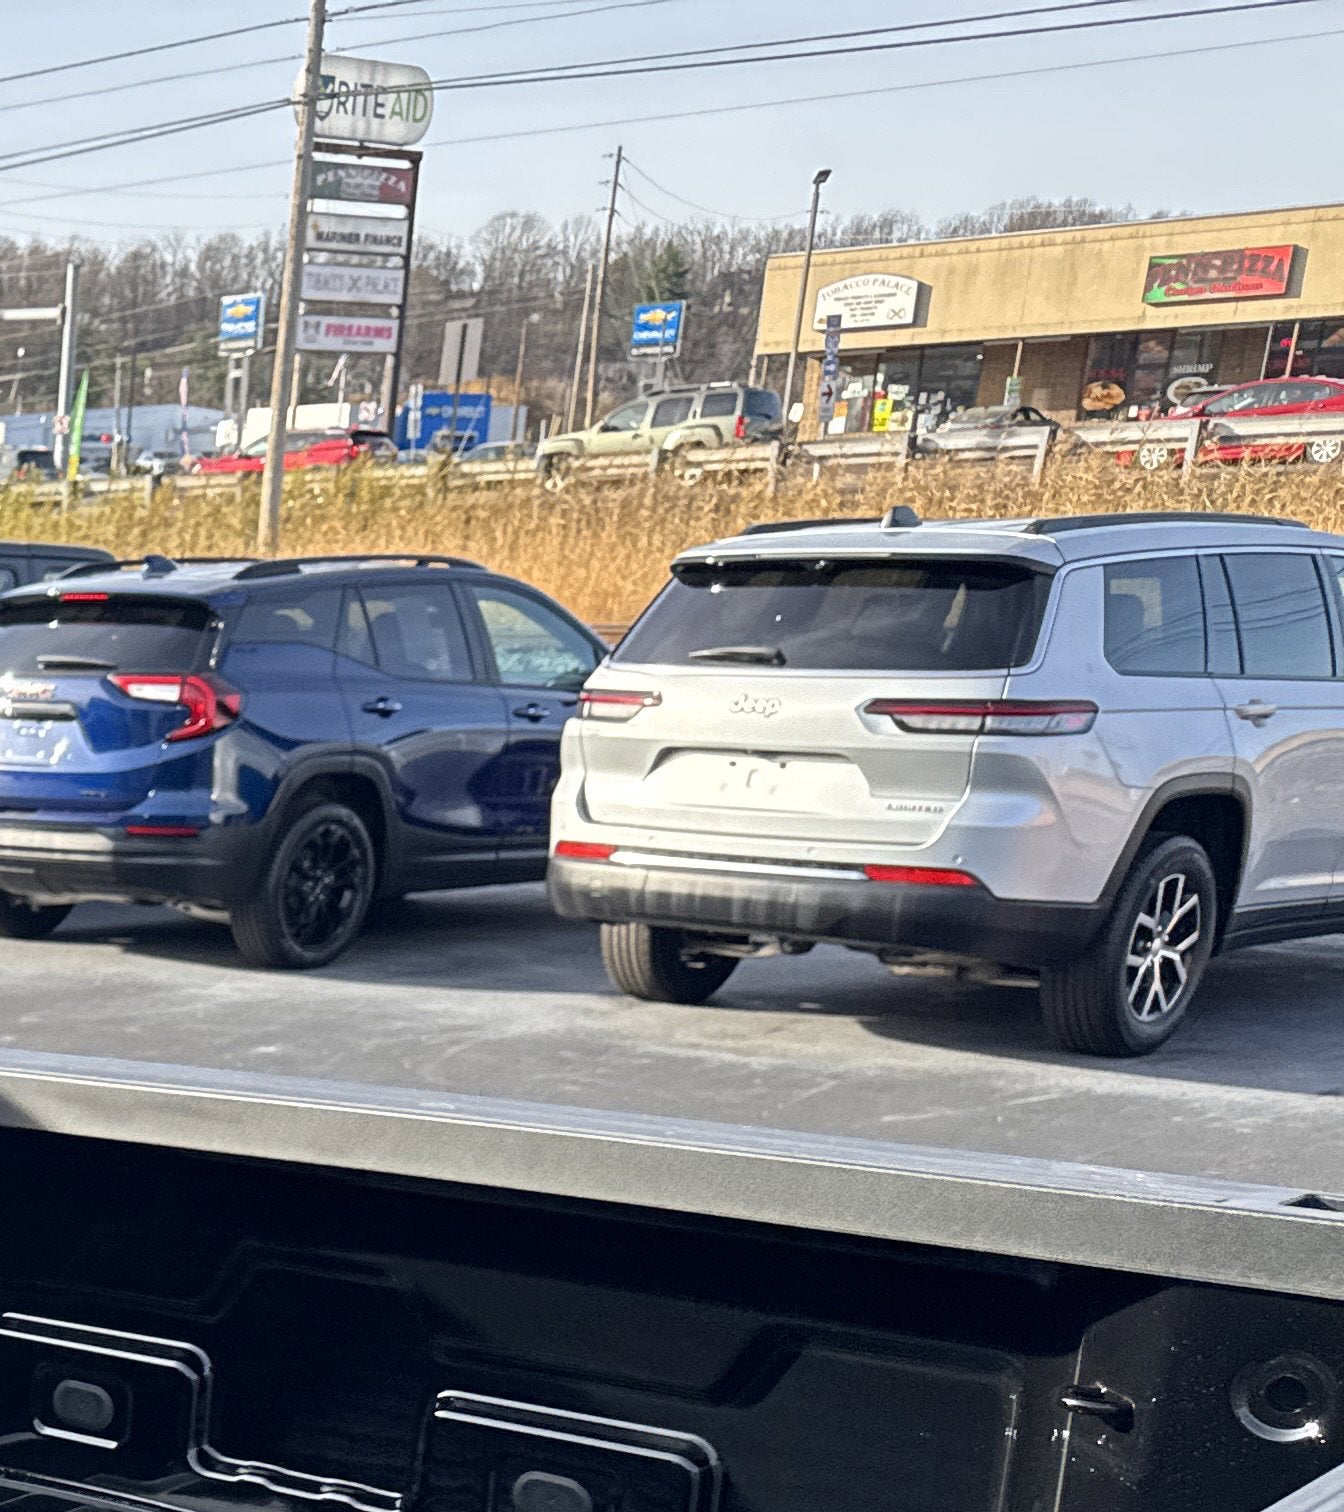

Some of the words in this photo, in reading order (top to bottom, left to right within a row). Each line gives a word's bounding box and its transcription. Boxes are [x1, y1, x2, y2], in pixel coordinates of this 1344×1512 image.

[335, 79, 386, 119] RITE
[389, 89, 429, 123] AID
[871, 277, 912, 296] PALACE
[325, 322, 393, 339] FIREARMS
[728, 693, 782, 718] Jeep
